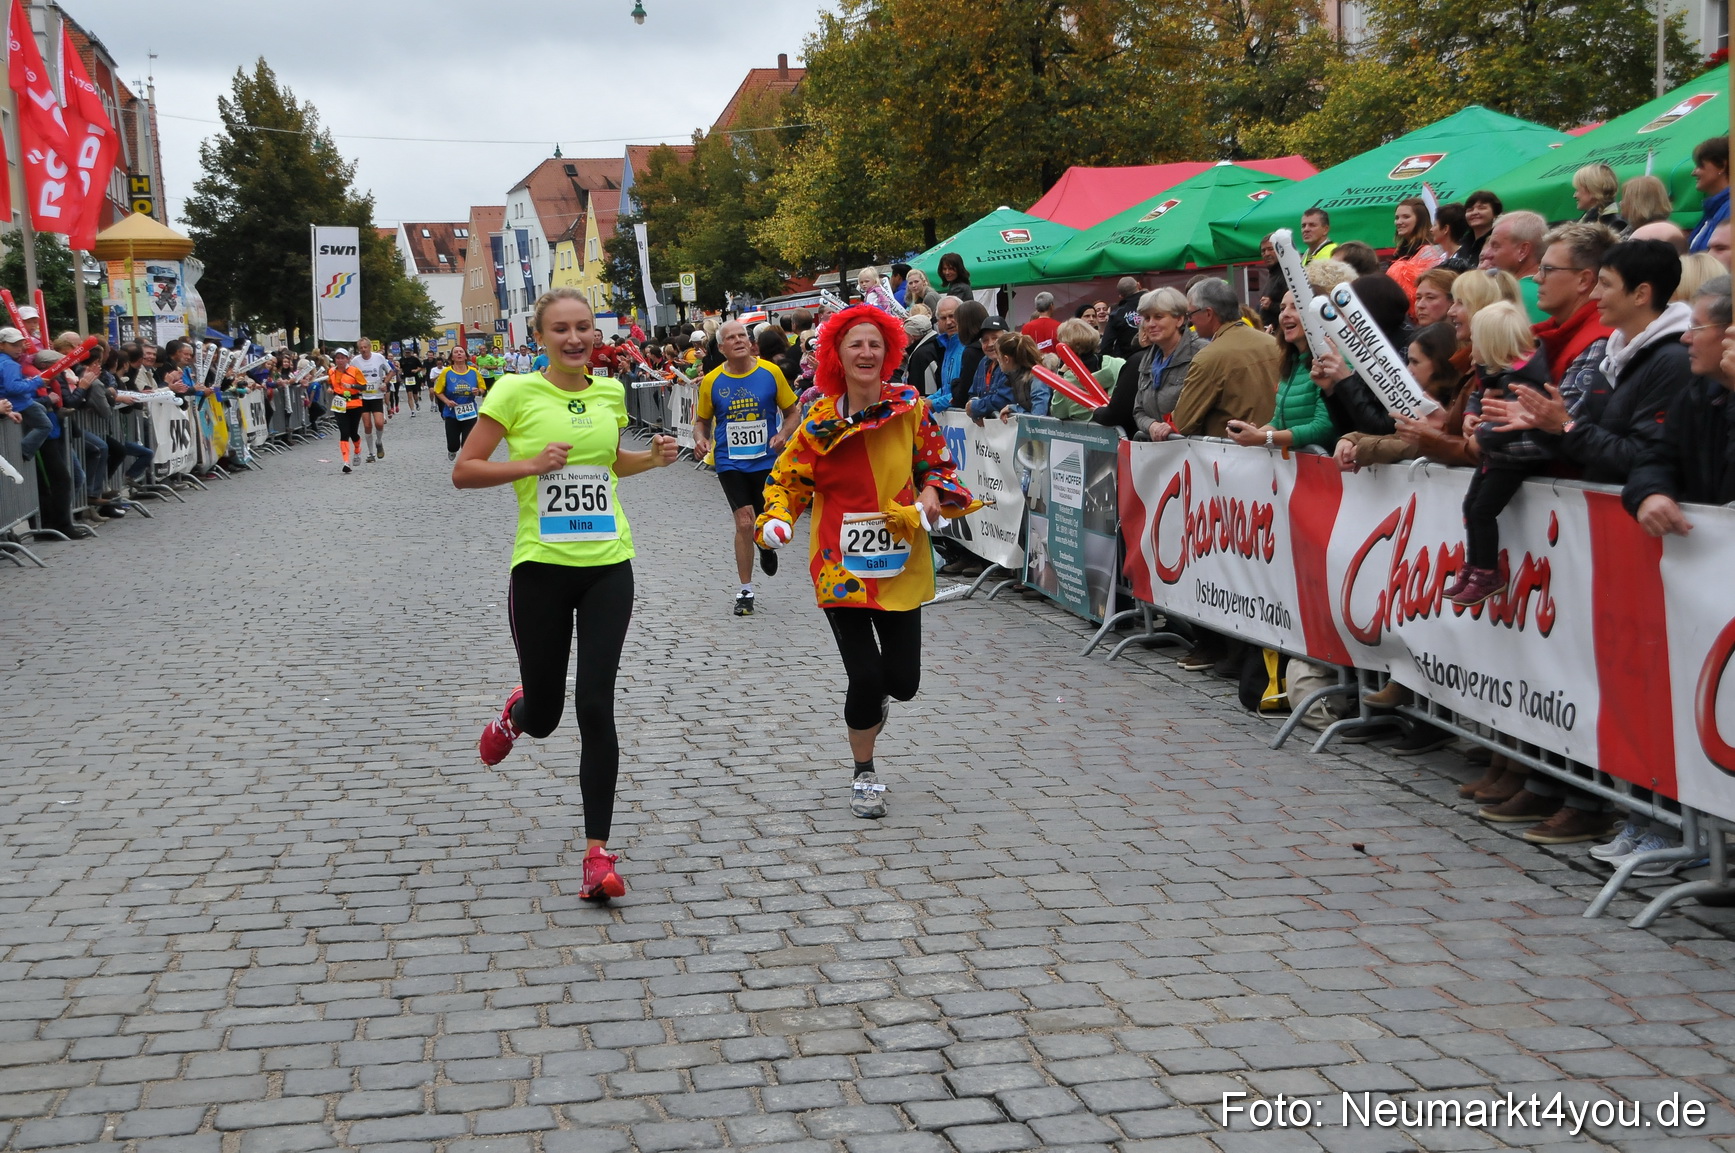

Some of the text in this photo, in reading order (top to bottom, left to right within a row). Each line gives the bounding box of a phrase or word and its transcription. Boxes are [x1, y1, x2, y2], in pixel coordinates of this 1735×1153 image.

[319, 245, 357, 256] swn
[1337, 325, 1372, 364] BMW
[1349, 310, 1422, 407] BMW Laufsport
[456, 404, 474, 414] 2443
[731, 429, 764, 445] 3301
[546, 484, 608, 512] 2556
[569, 519, 593, 530] Nina
[1151, 459, 1278, 585] Charivari
[866, 558, 888, 569] Gabi
[1195, 578, 1292, 630] Ostbayerns Radio
[1519, 683, 1577, 732] Radio
